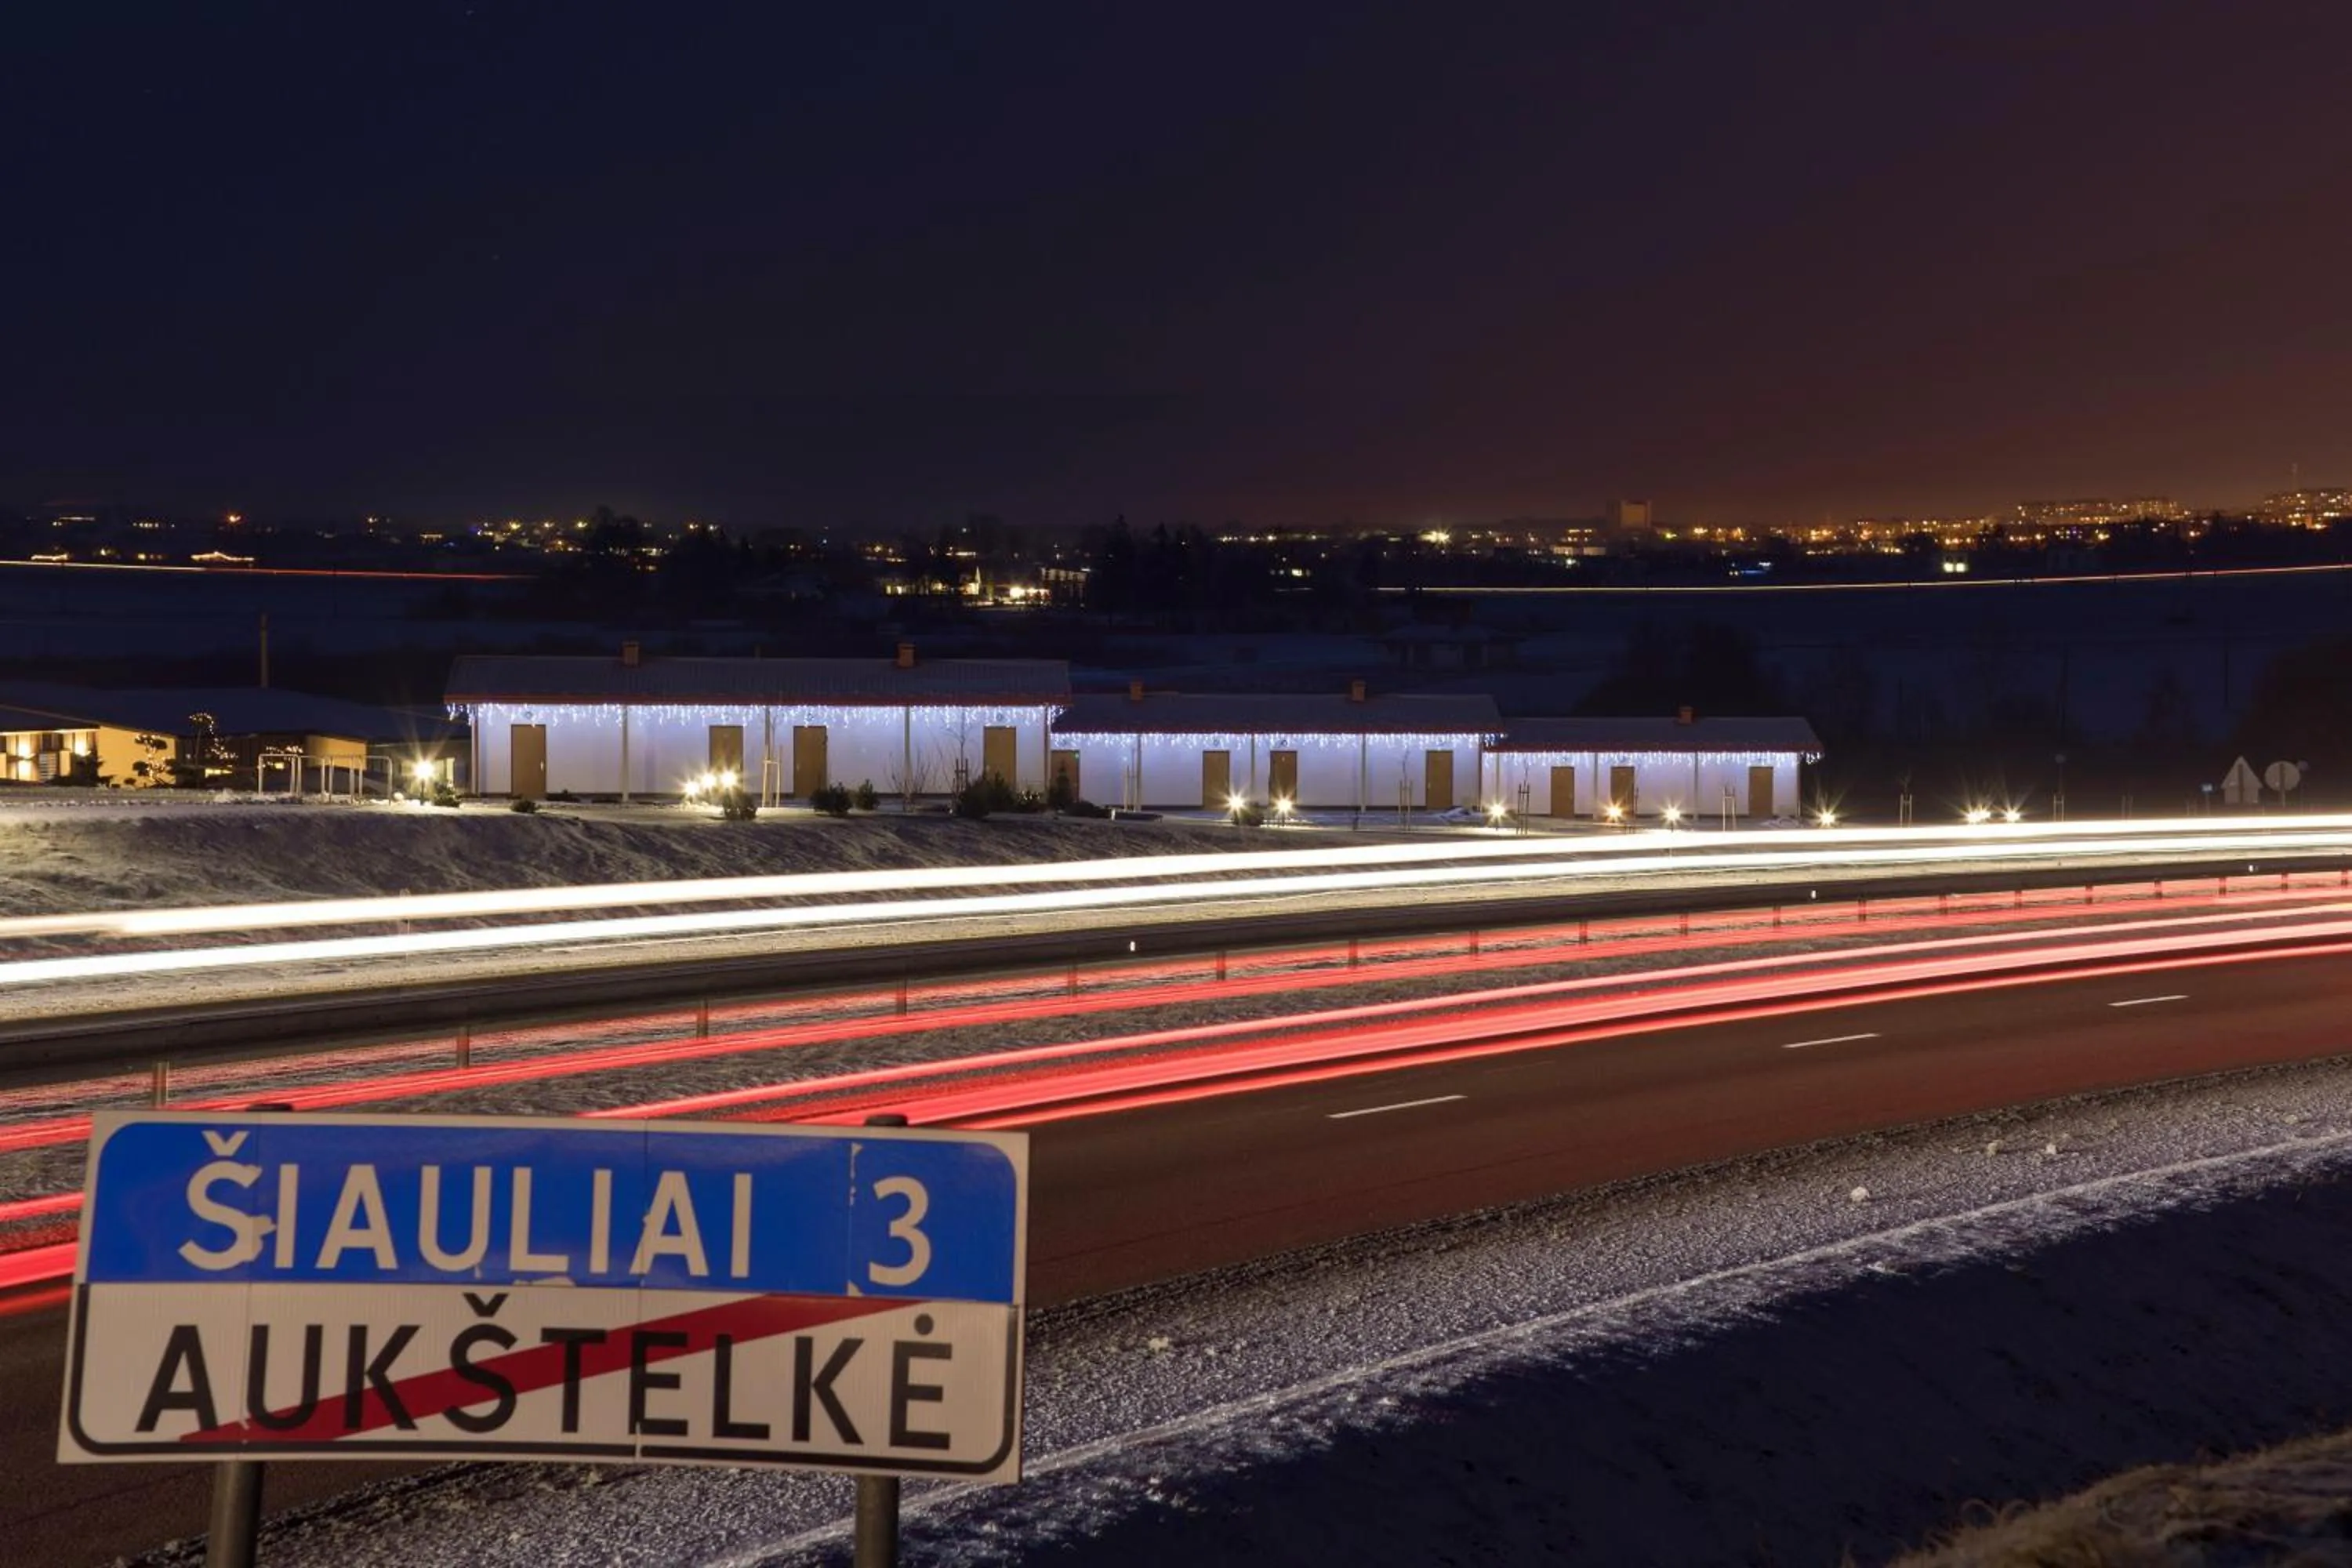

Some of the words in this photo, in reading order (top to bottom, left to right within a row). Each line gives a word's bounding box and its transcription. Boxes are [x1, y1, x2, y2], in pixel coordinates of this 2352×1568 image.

[180, 1131, 752, 1278] ŠIAULIAI
[869, 1177, 931, 1287] 3
[135, 1293, 953, 1450] AUKŠTELKĖ
